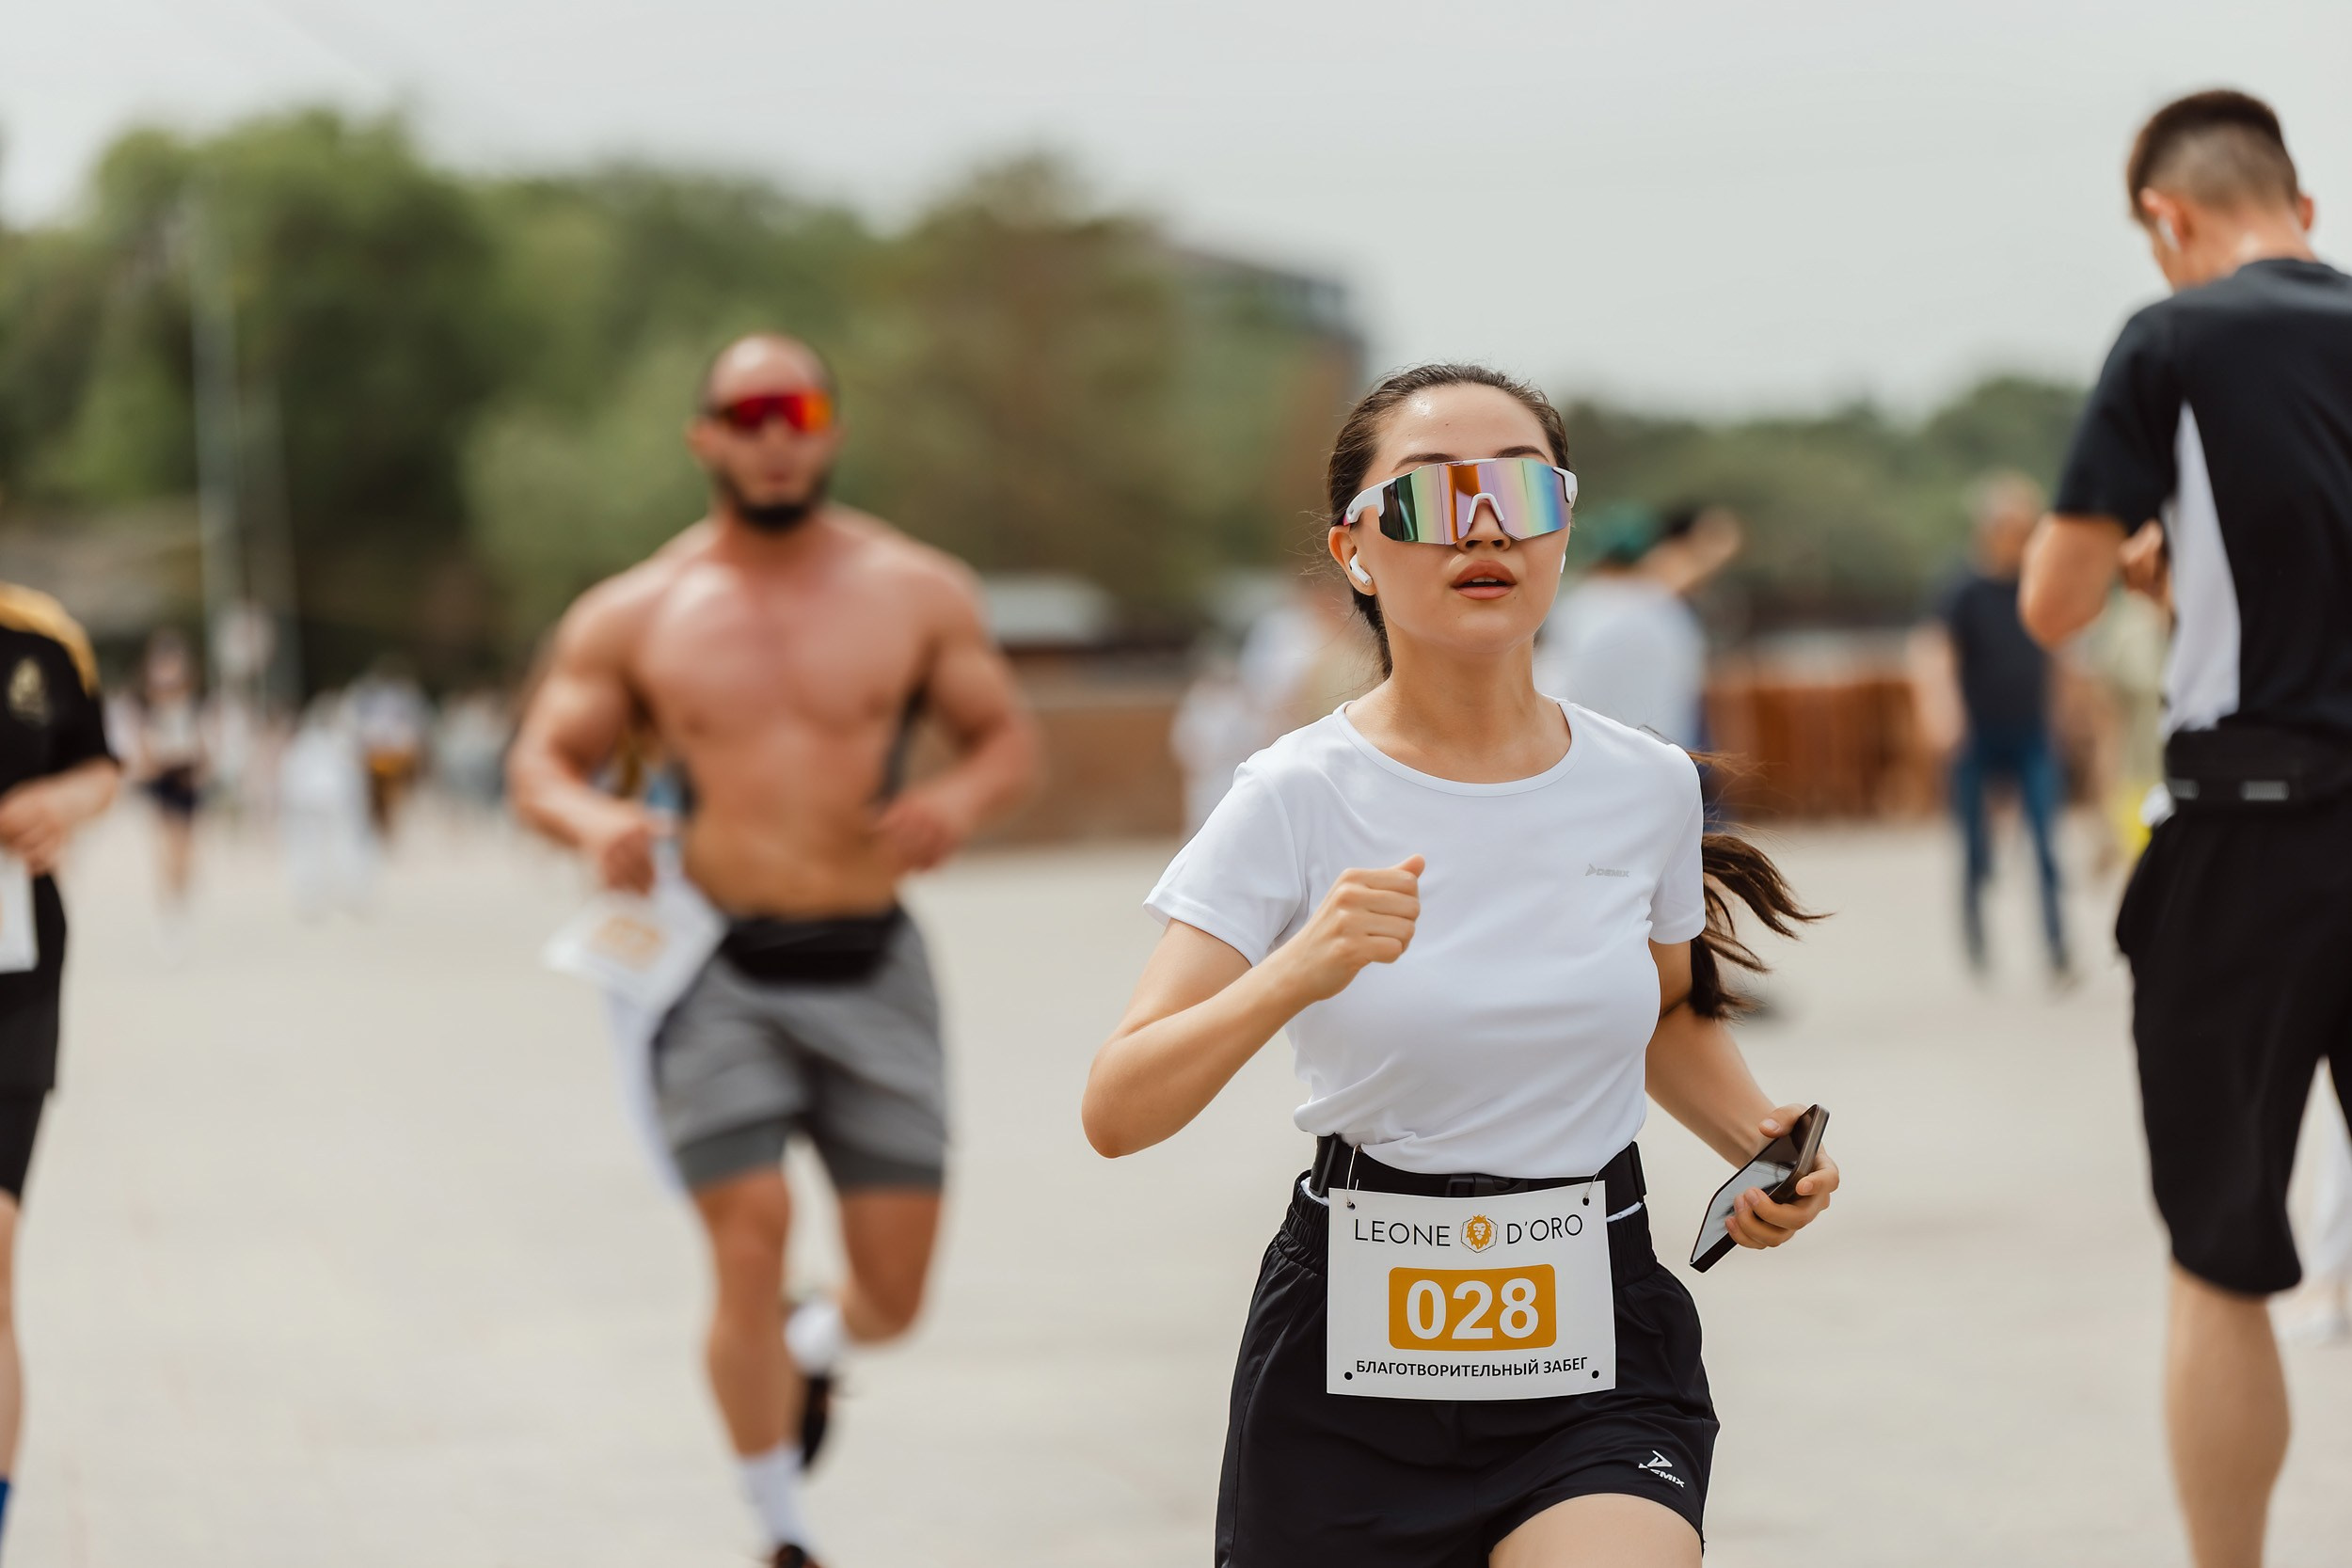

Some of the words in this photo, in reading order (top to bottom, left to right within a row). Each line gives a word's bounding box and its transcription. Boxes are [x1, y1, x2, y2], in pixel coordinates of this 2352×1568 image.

[1355, 1218, 1451, 1247] LEONE
[1506, 1213, 1584, 1244] D'ORO
[1406, 1277, 1539, 1340] 028
[1356, 1359, 1539, 1378] БЛАГОТВОРИТЕЛЬНЫЙ
[1543, 1356, 1588, 1373] ЗАБЕГ
